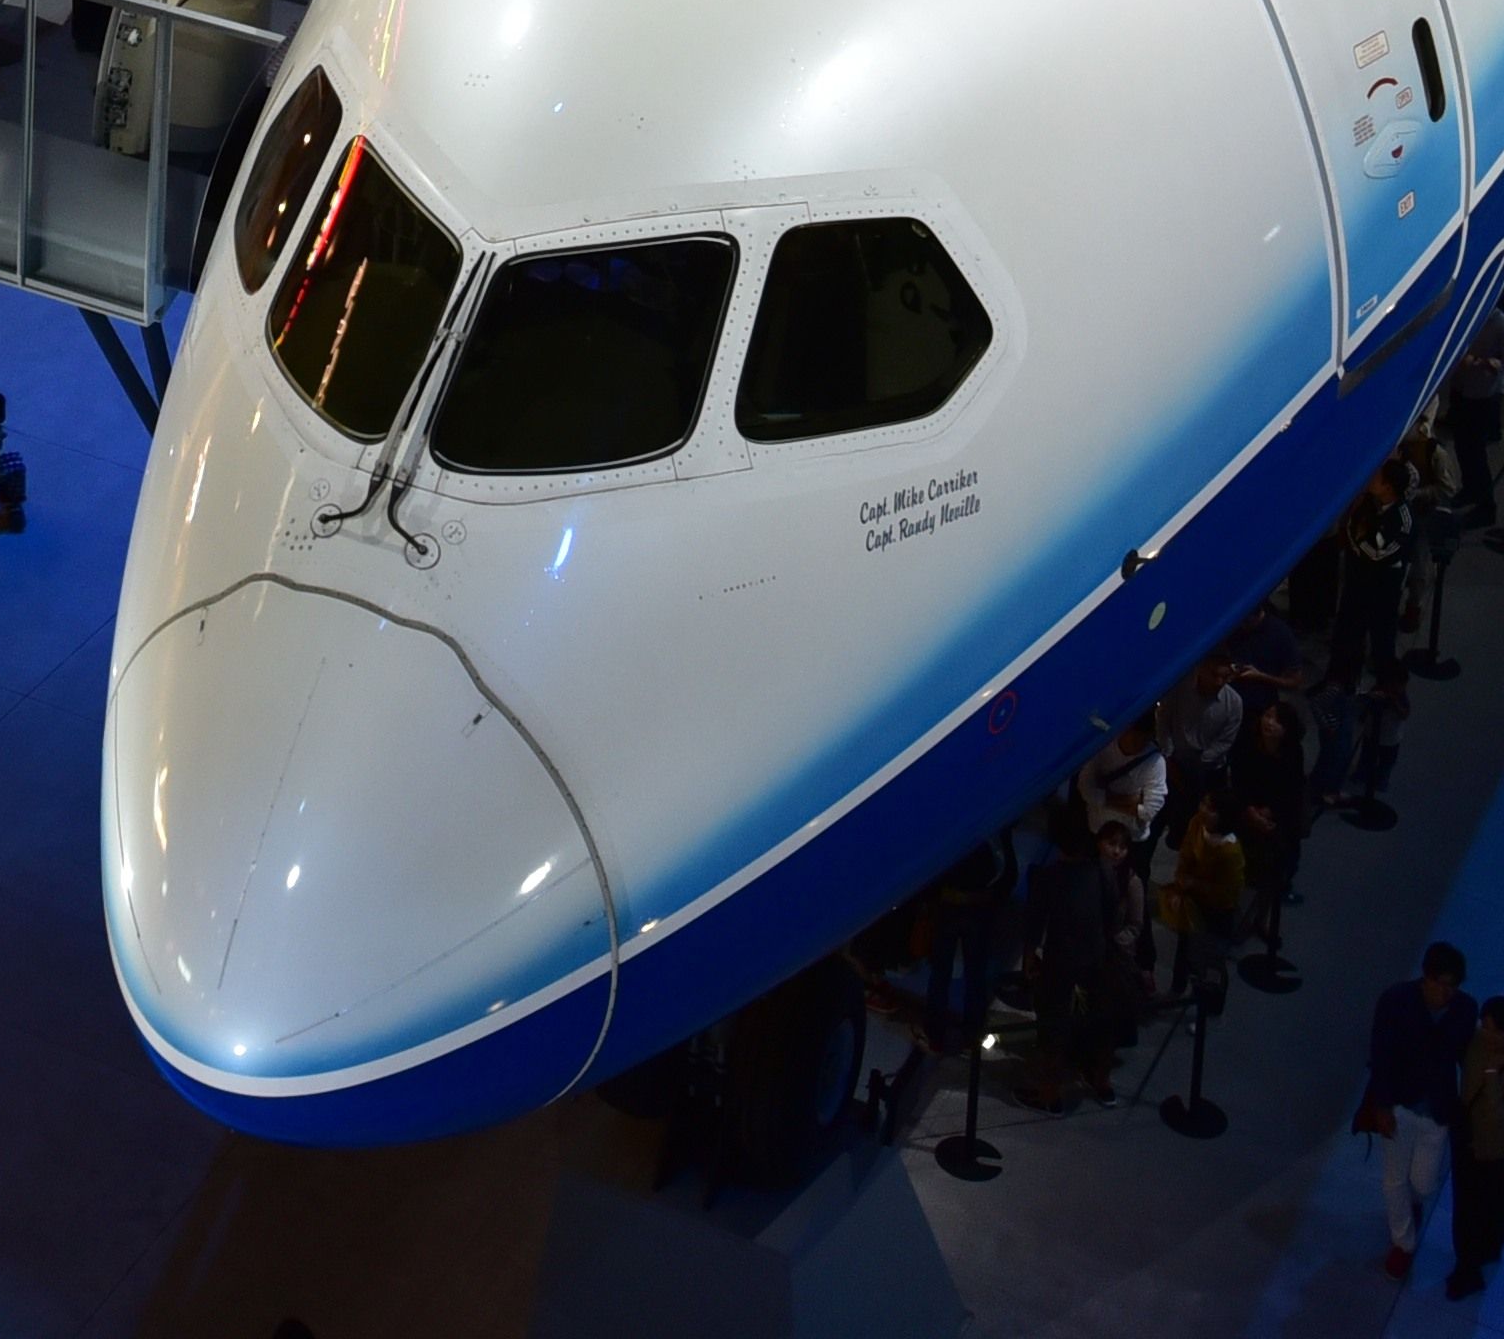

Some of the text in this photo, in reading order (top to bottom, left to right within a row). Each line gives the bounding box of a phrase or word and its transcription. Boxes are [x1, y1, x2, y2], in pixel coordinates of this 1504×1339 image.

[860, 469, 978, 524] Capt. Mike Carriker
[866, 494, 981, 552] Capt. Randy Neville
